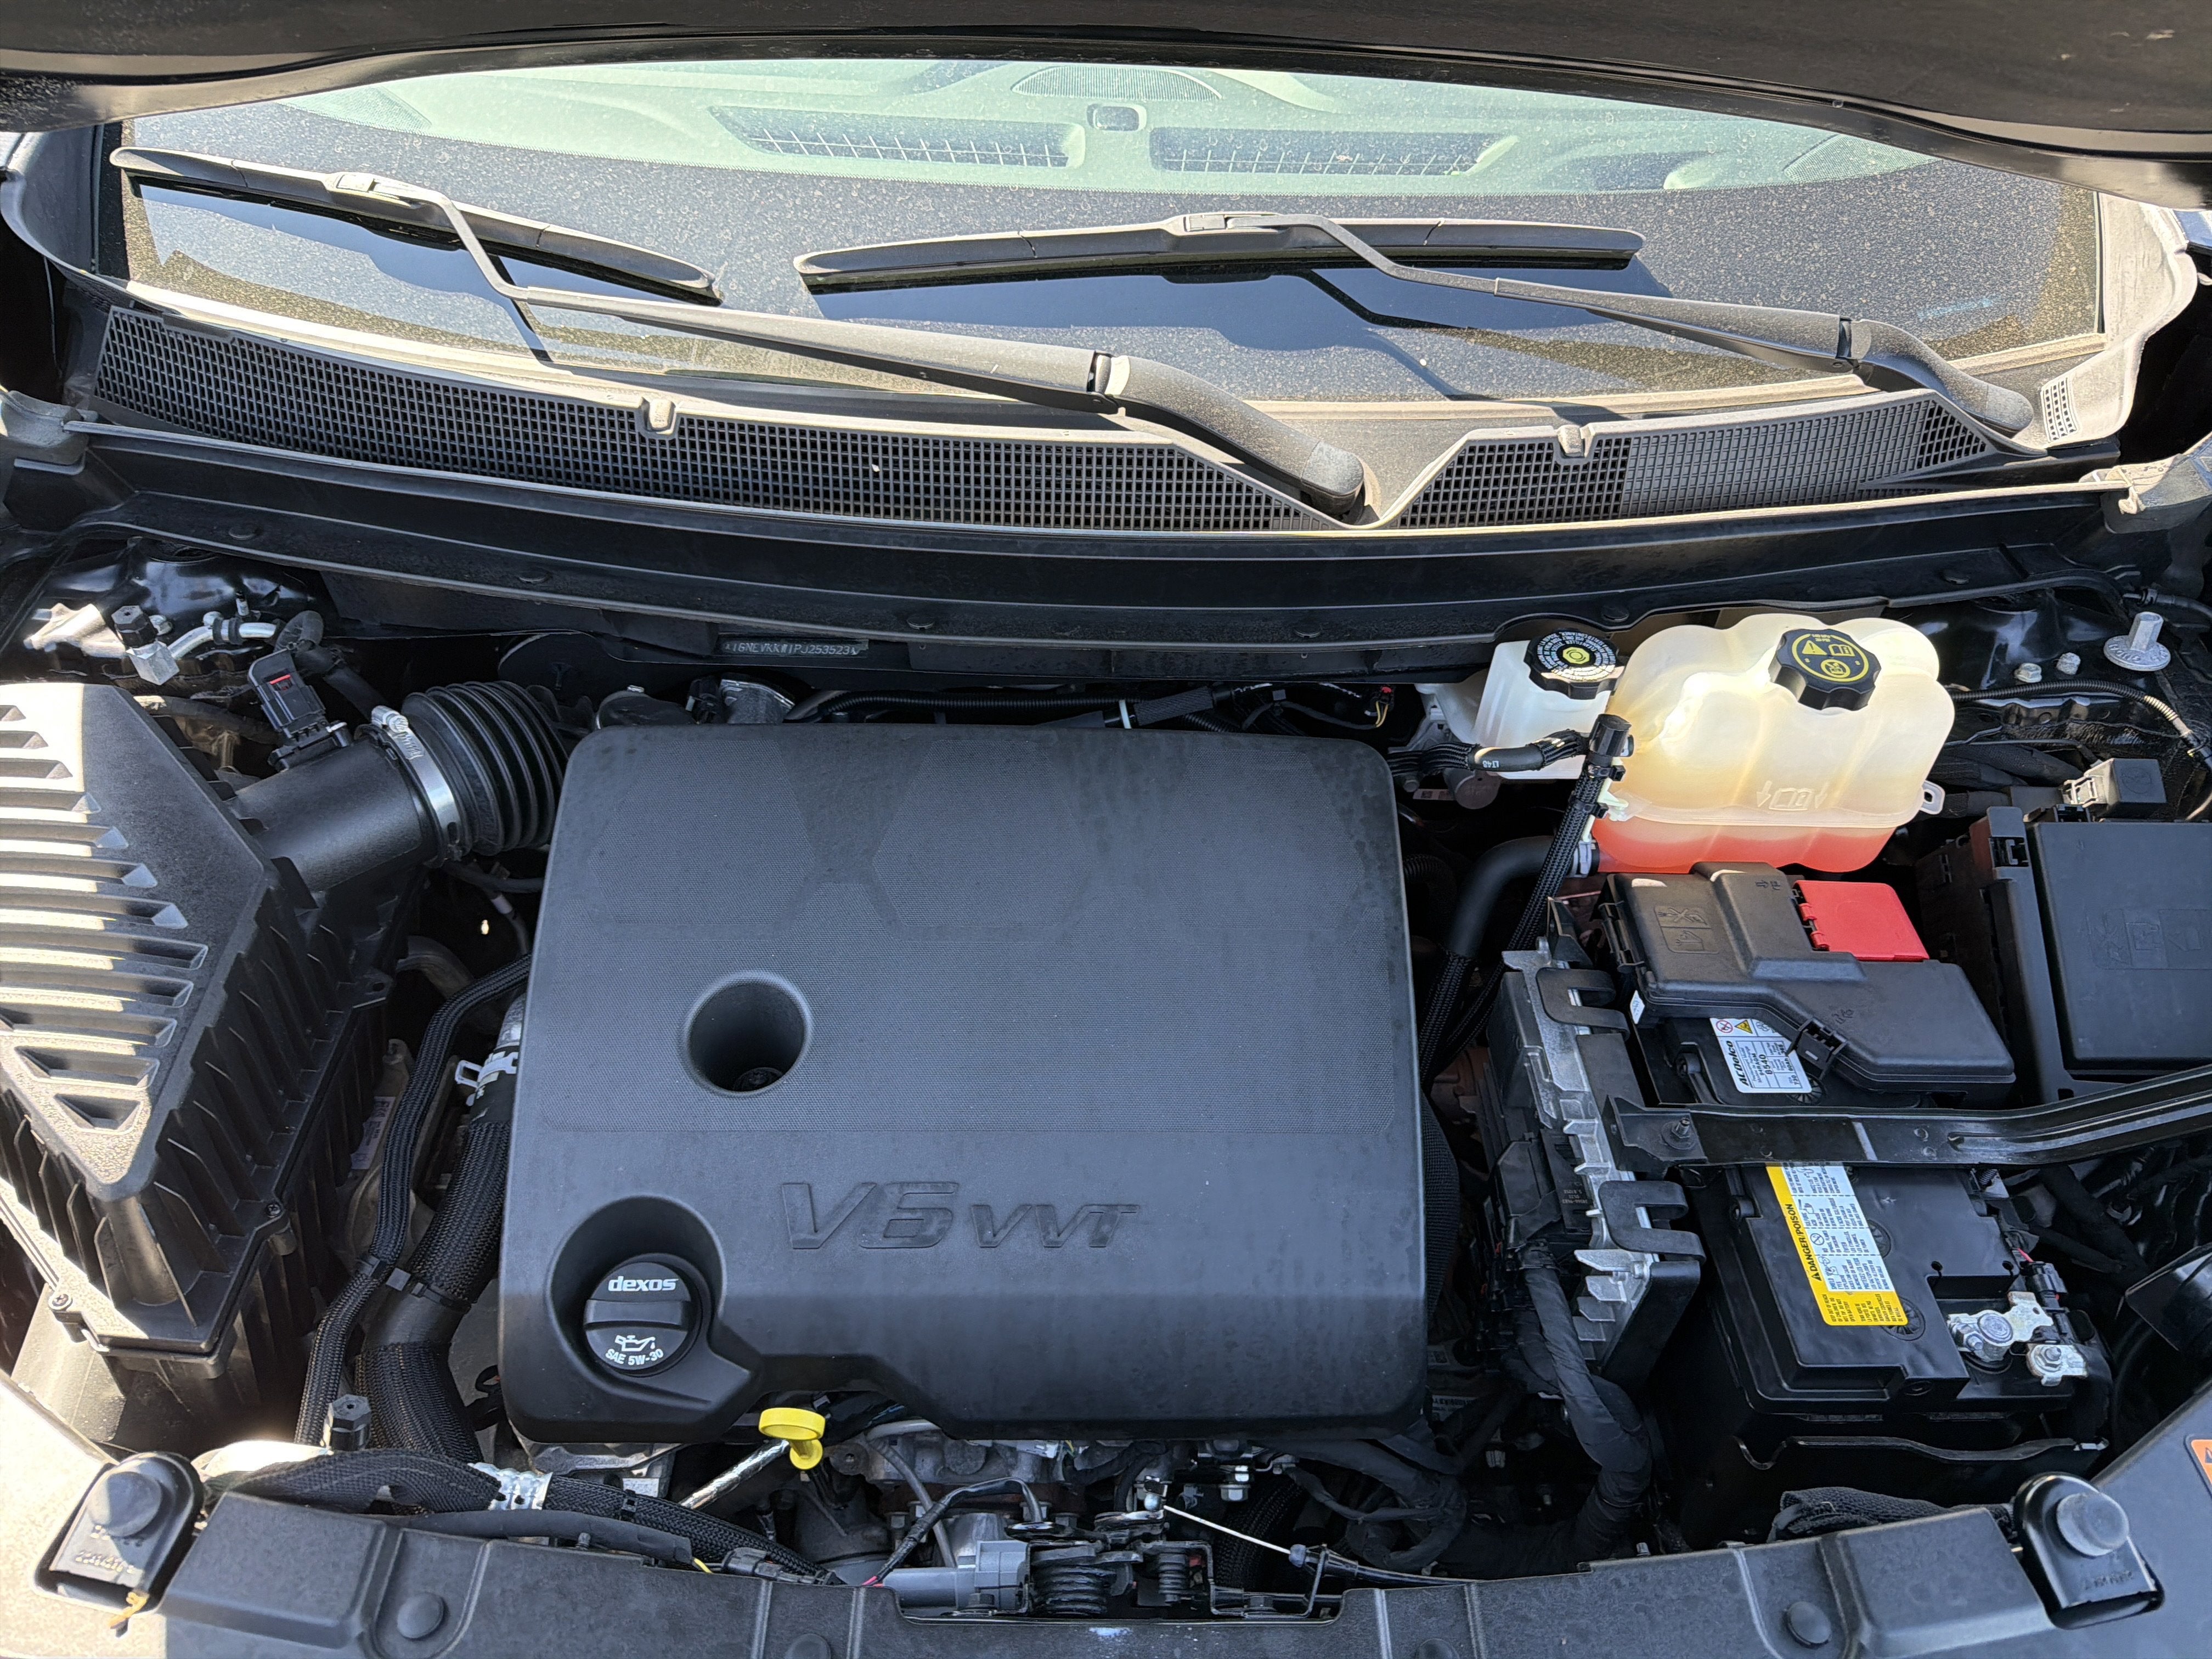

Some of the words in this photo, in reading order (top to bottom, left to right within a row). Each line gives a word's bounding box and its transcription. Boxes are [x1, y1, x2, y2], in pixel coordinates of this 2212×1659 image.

[1726, 1040, 1749, 1086] ACDelco
[781, 1181, 960, 1250] V6
[970, 1204, 1141, 1248] VVT
[1785, 1204, 1818, 1271] DANGER/POISON
[608, 1276, 679, 1292] dexos
[605, 1348, 626, 1364] SAE
[628, 1349, 664, 1365] 5W-30
